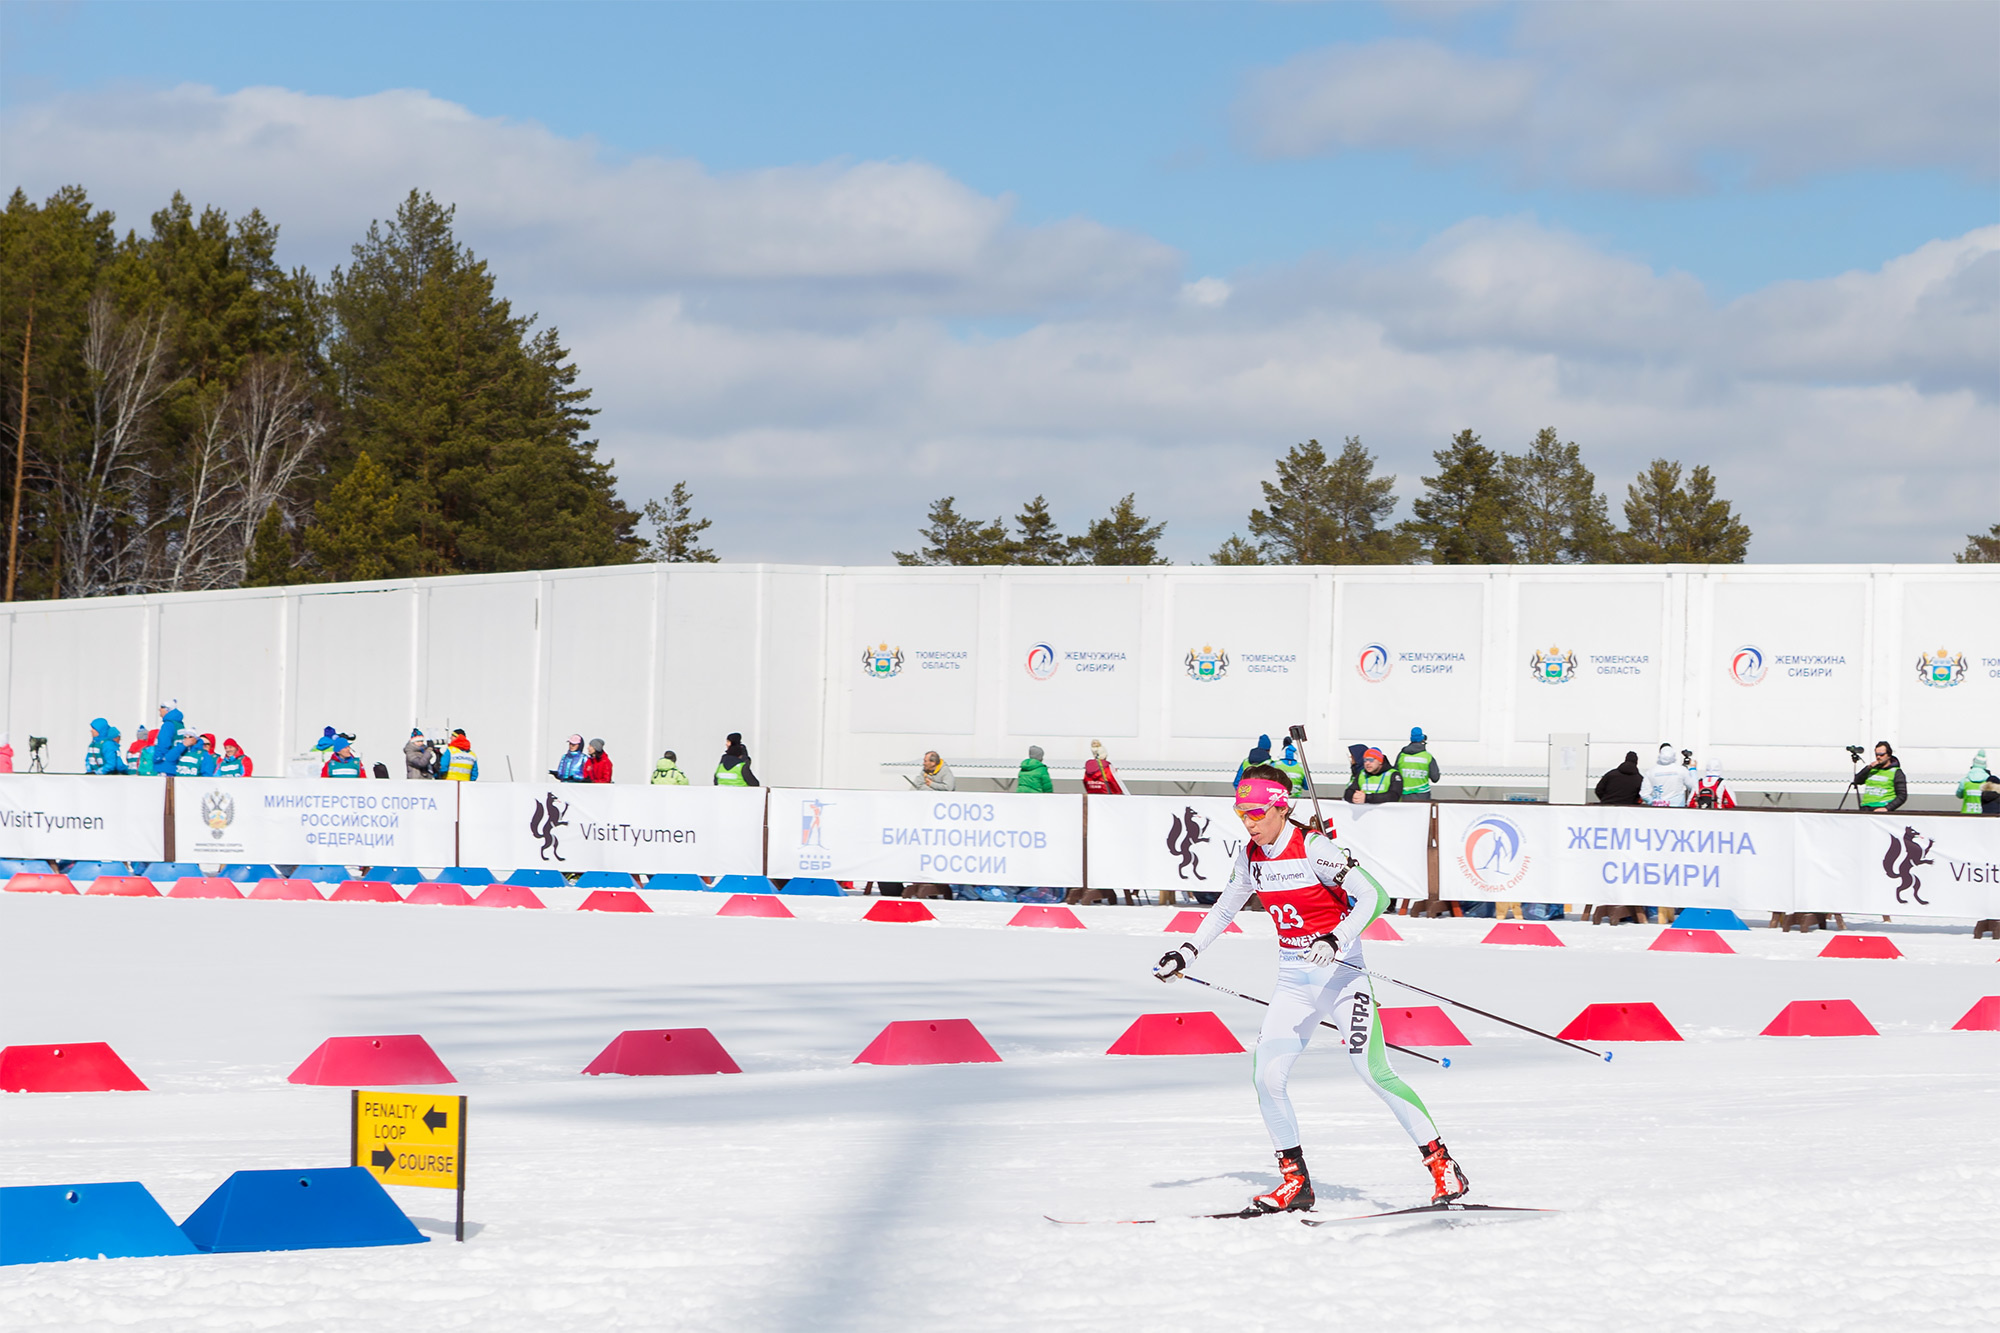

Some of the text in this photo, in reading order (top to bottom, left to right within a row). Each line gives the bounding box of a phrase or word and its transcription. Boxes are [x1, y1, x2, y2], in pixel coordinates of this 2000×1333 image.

[916, 650, 968, 660] ТЮМЕНСКАЯ
[1064, 651, 1127, 661] ЖЕМЧУЖИНА
[1241, 653, 1297, 663] ТЮМЕНСКАЯ
[1399, 652, 1465, 662] ЖЕМЧУЖИНА
[1590, 655, 1649, 664] ТЮМЕНСКАЯ
[1775, 655, 1846, 665] ЖЕМЧУЖИНА
[921, 661, 961, 670] ОБЛАСТЬ
[1075, 663, 1115, 673] СИБИРИ
[1247, 664, 1289, 674] ОБЛАСТЬ
[1410, 664, 1453, 674] СИБИРИ
[1596, 665, 1641, 675] ОБЛАСТЬ
[1787, 667, 1832, 678] СИБИРИ
[264, 794, 438, 811] МИНИСТЕРСТВО СПОРТА
[933, 802, 995, 822] СОЮЗ
[0, 810, 104, 833] VisitTyumen
[300, 811, 399, 828] РОССИЙСКОЙ
[305, 831, 394, 849] ФЕДЕРАЦИИ
[580, 822, 696, 847] VisitTyumen
[881, 827, 1048, 850] БИАТЛОНИСТОВ
[1567, 826, 1757, 856] ЖЕМЧУЖИНА
[799, 860, 832, 871] СБР
[919, 853, 1007, 875] РОССИИ
[1316, 858, 1345, 869] CRAFT
[1265, 872, 1305, 882] VisitTyumen
[1601, 860, 1721, 888] СИБИРИ
[1269, 903, 1305, 929] 23
[364, 1102, 418, 1120] PENALTY
[374, 1124, 407, 1140] LOOP
[398, 1153, 454, 1173] COURSE
